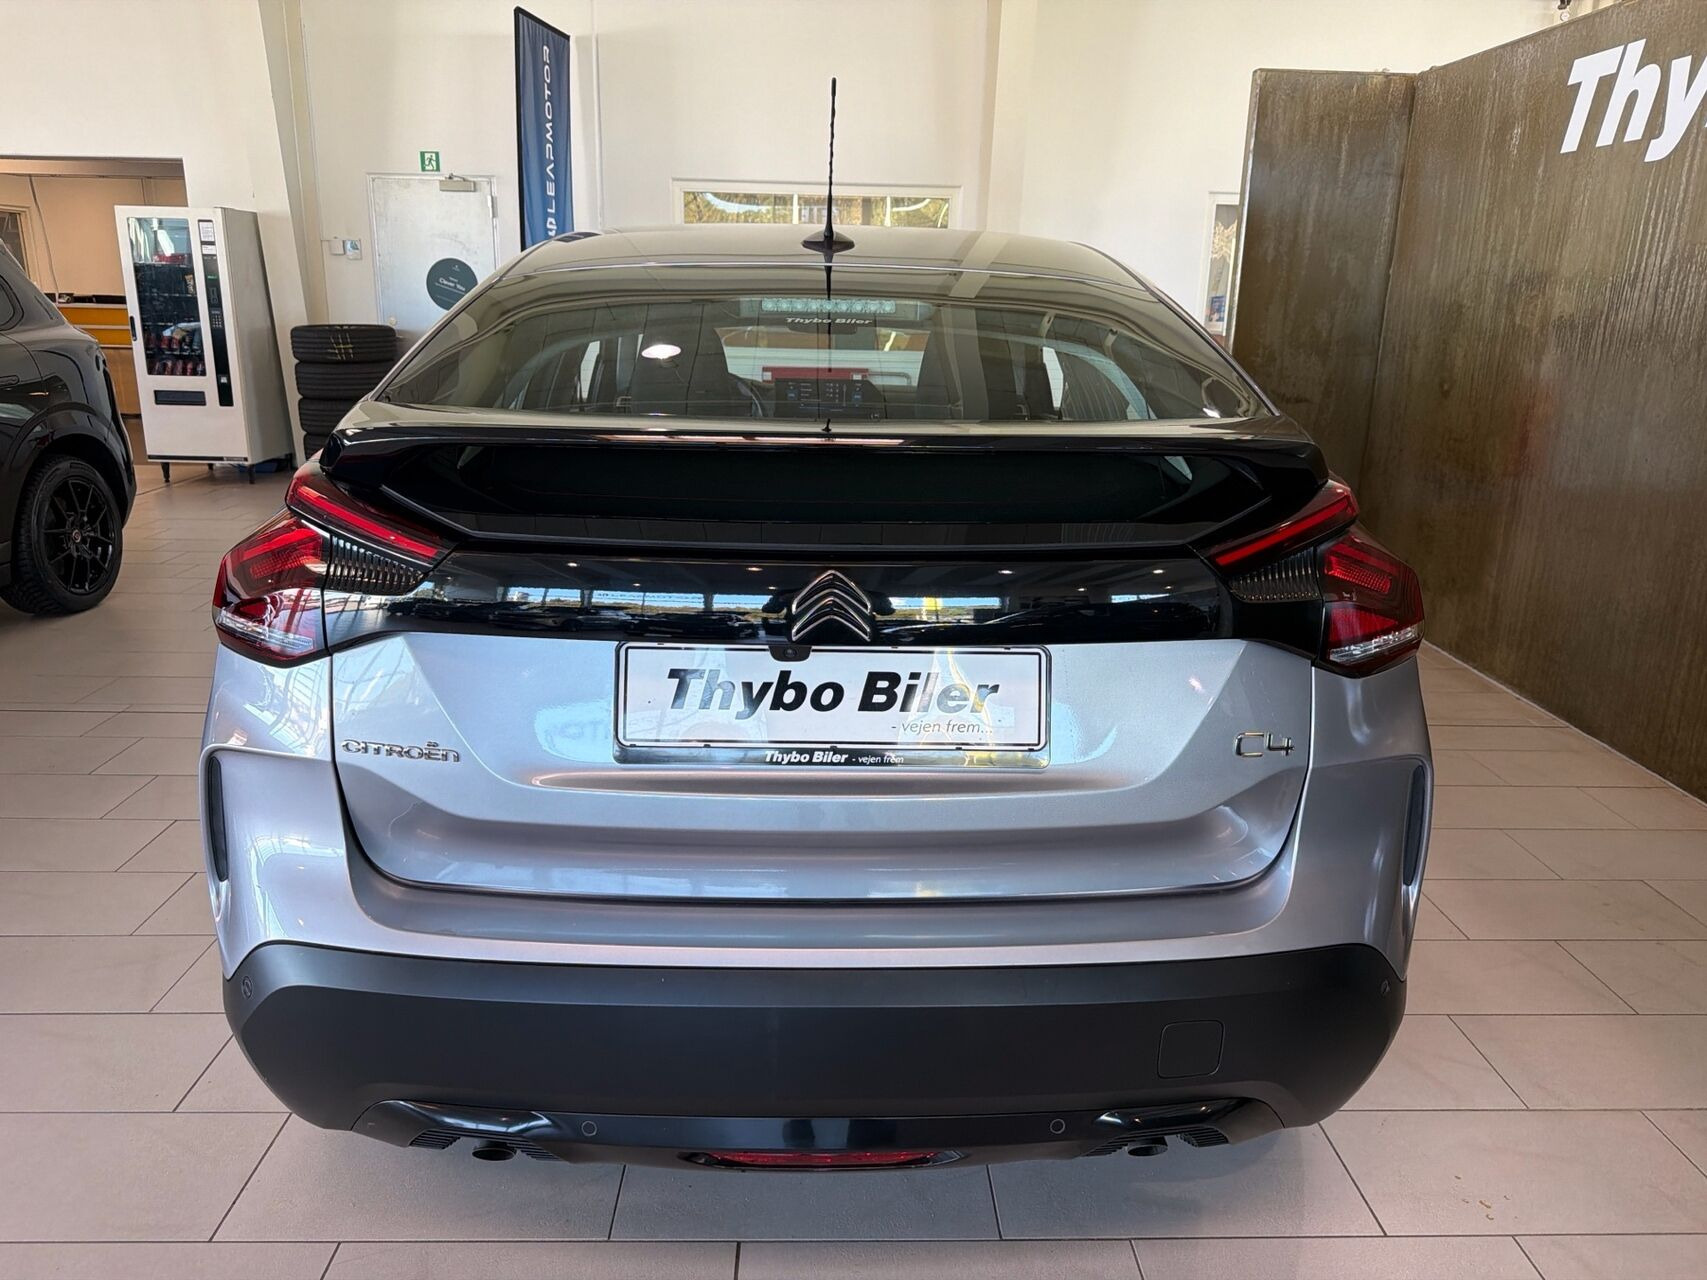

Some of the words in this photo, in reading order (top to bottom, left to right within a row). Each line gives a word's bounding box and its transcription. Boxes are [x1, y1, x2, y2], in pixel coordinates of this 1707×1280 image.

[1560, 38, 1707, 163] Thy
[543, 44, 556, 214] LEAPMOTOR
[785, 317, 832, 325] Thybo
[667, 668, 845, 720] Thybo
[857, 671, 1000, 714] Biler
[901, 719, 941, 736] vejen
[1234, 731, 1295, 757] C4
[765, 751, 810, 765] Thybo
[811, 751, 849, 763] Biler
[858, 754, 881, 765] vejen
